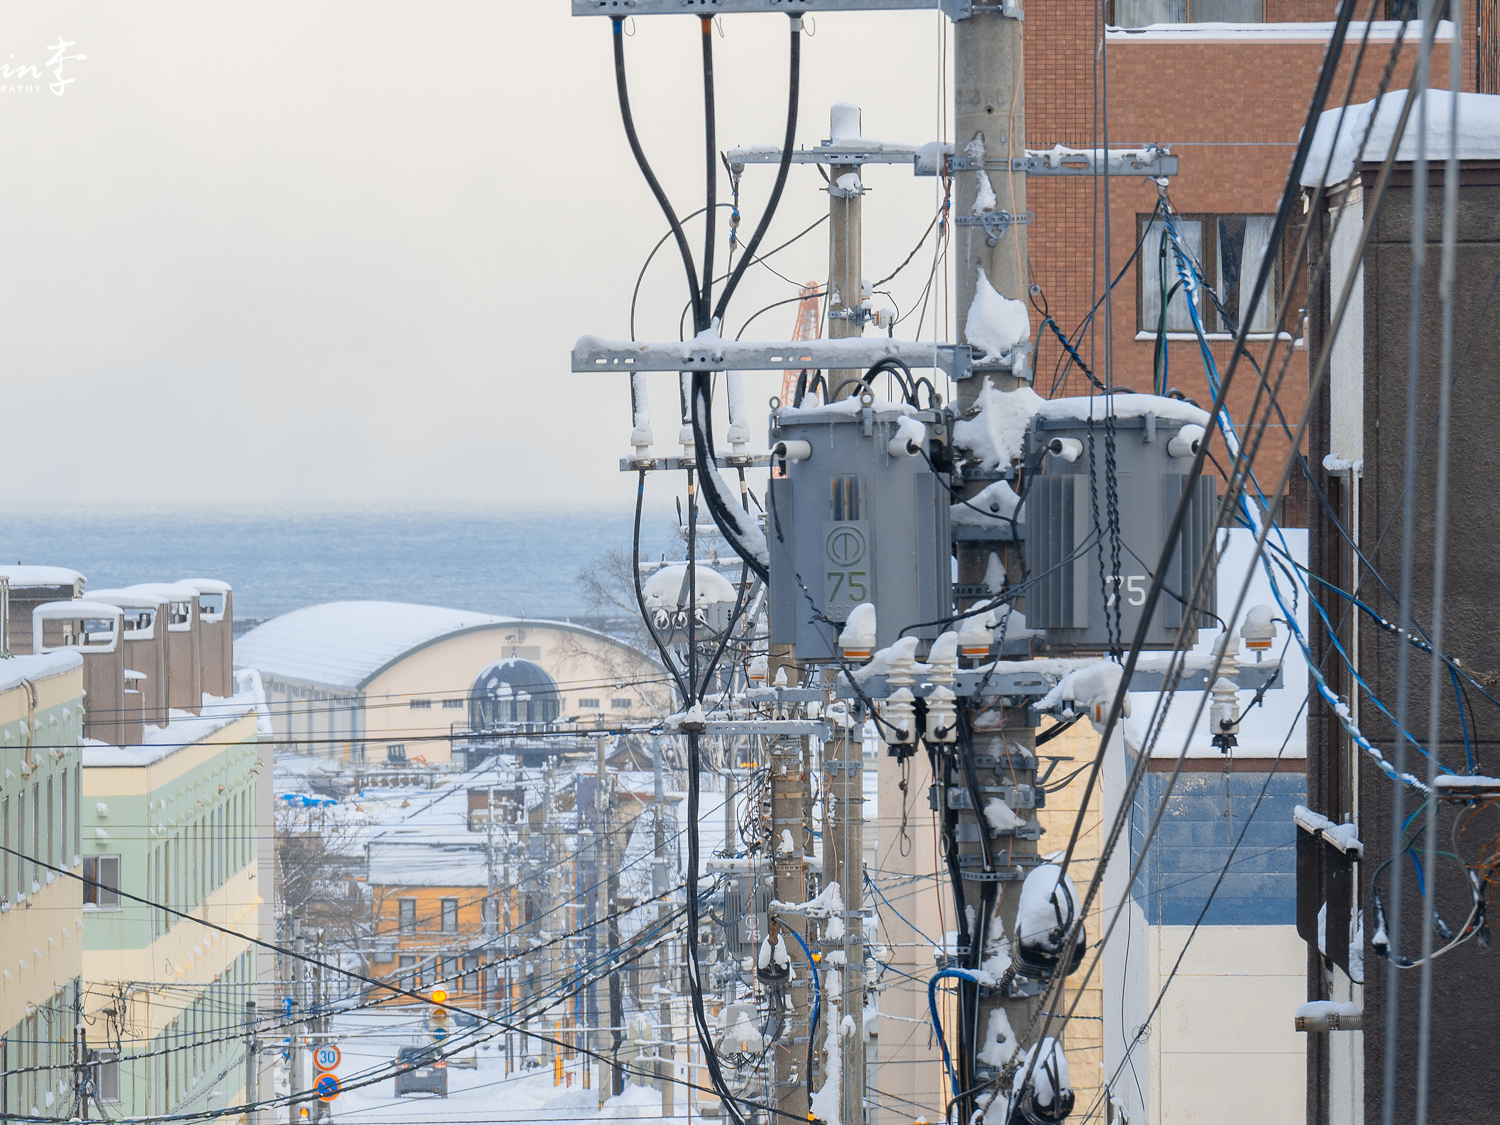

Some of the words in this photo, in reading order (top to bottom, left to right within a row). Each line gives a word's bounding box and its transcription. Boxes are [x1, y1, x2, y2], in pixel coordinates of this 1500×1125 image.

[827, 571, 868, 602] 75
[1105, 575, 1146, 607] 75
[745, 930, 761, 941] 75
[319, 1050, 336, 1064] 30
